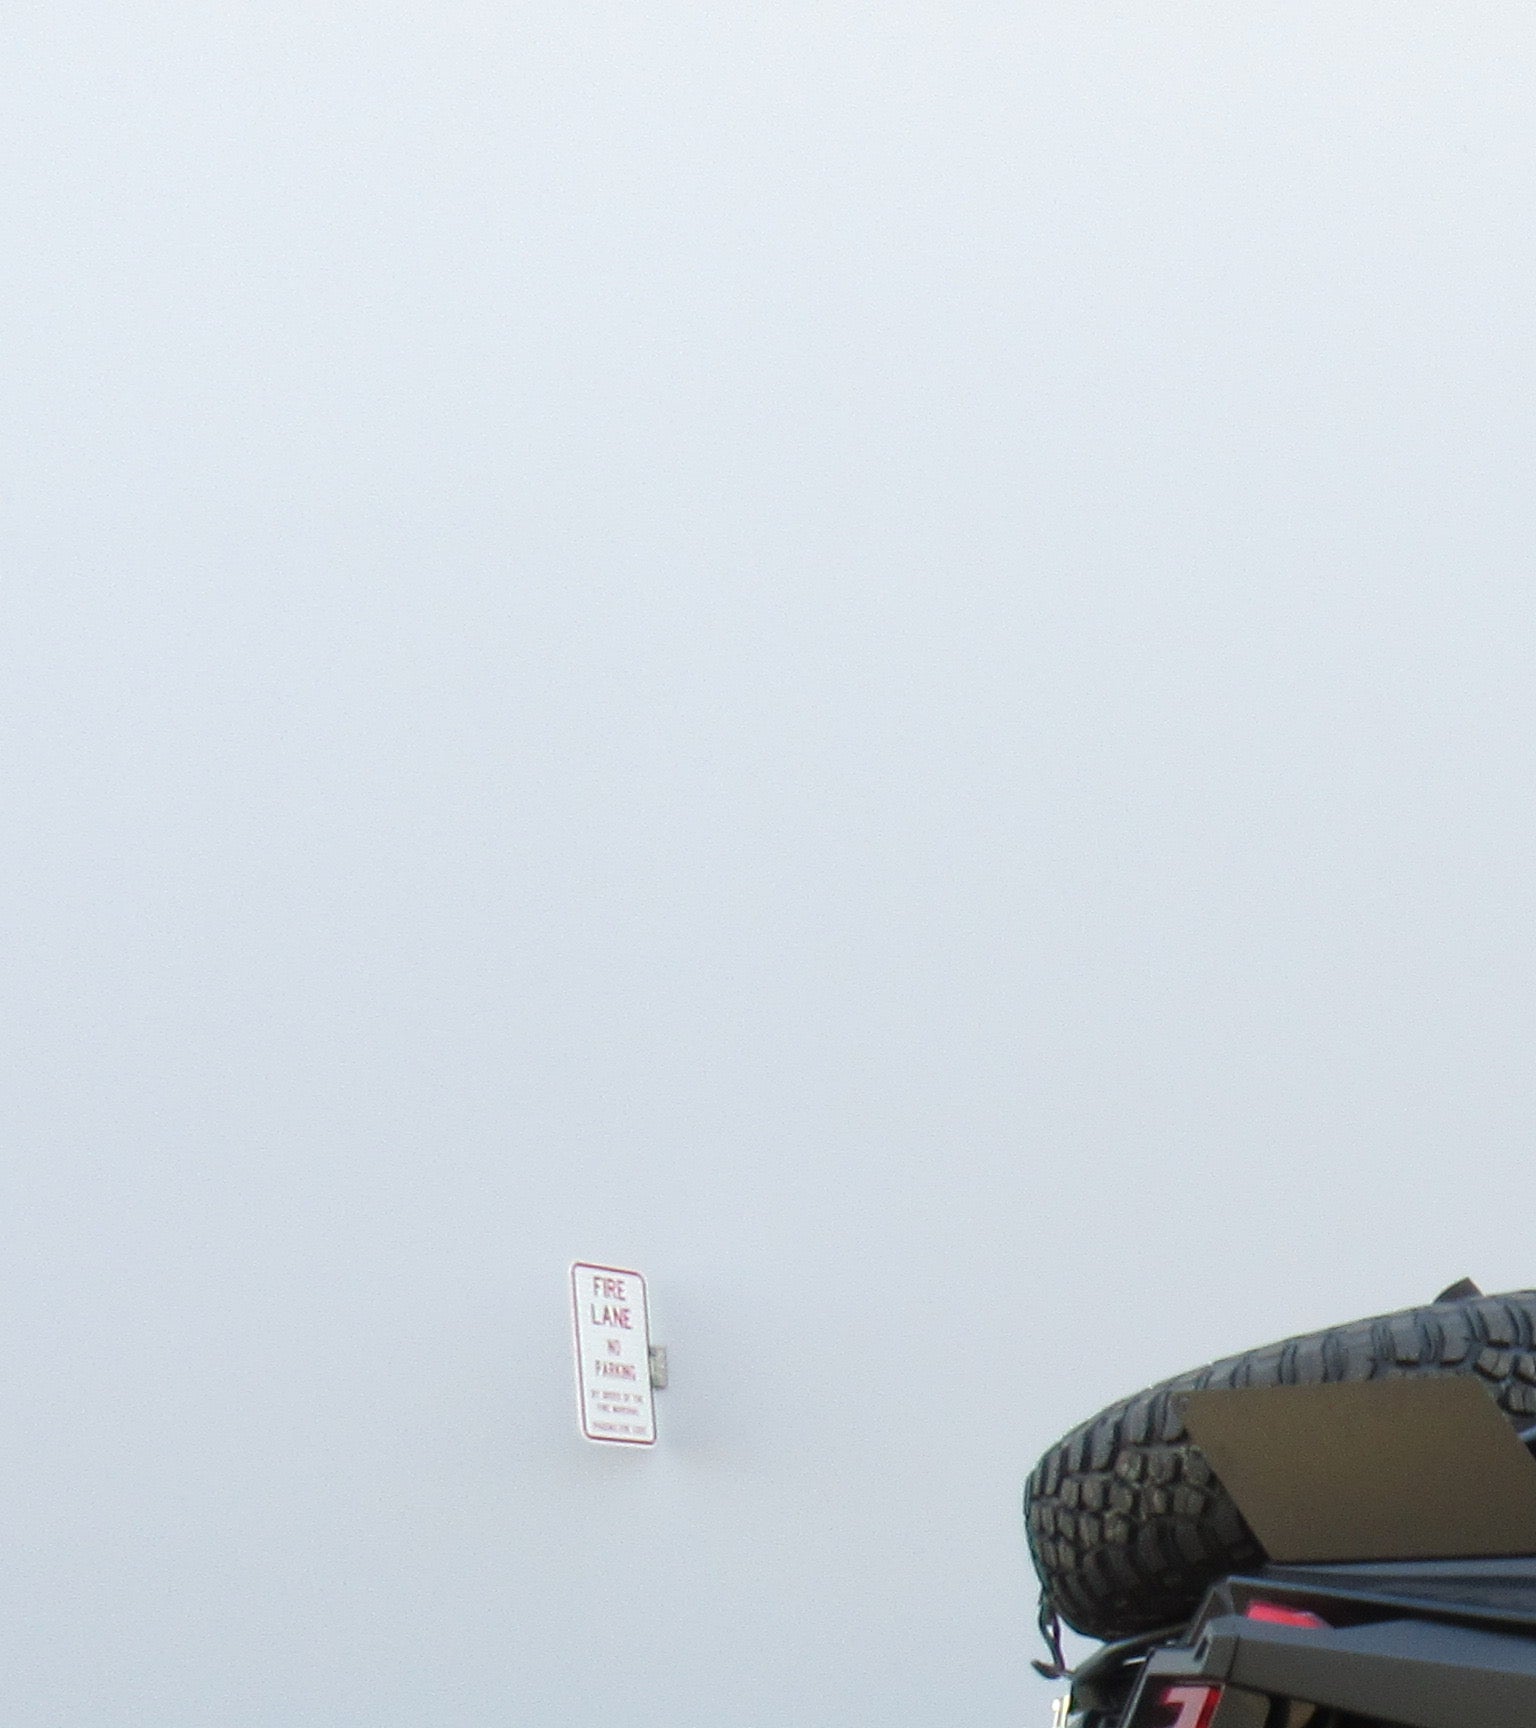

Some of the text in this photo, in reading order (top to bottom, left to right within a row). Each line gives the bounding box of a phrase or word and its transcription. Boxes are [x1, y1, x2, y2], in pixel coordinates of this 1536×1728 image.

[593, 1276, 626, 1301] FIRE
[591, 1303, 633, 1330] LANE
[606, 1339, 622, 1356] NO
[595, 1359, 636, 1382] PARKING
